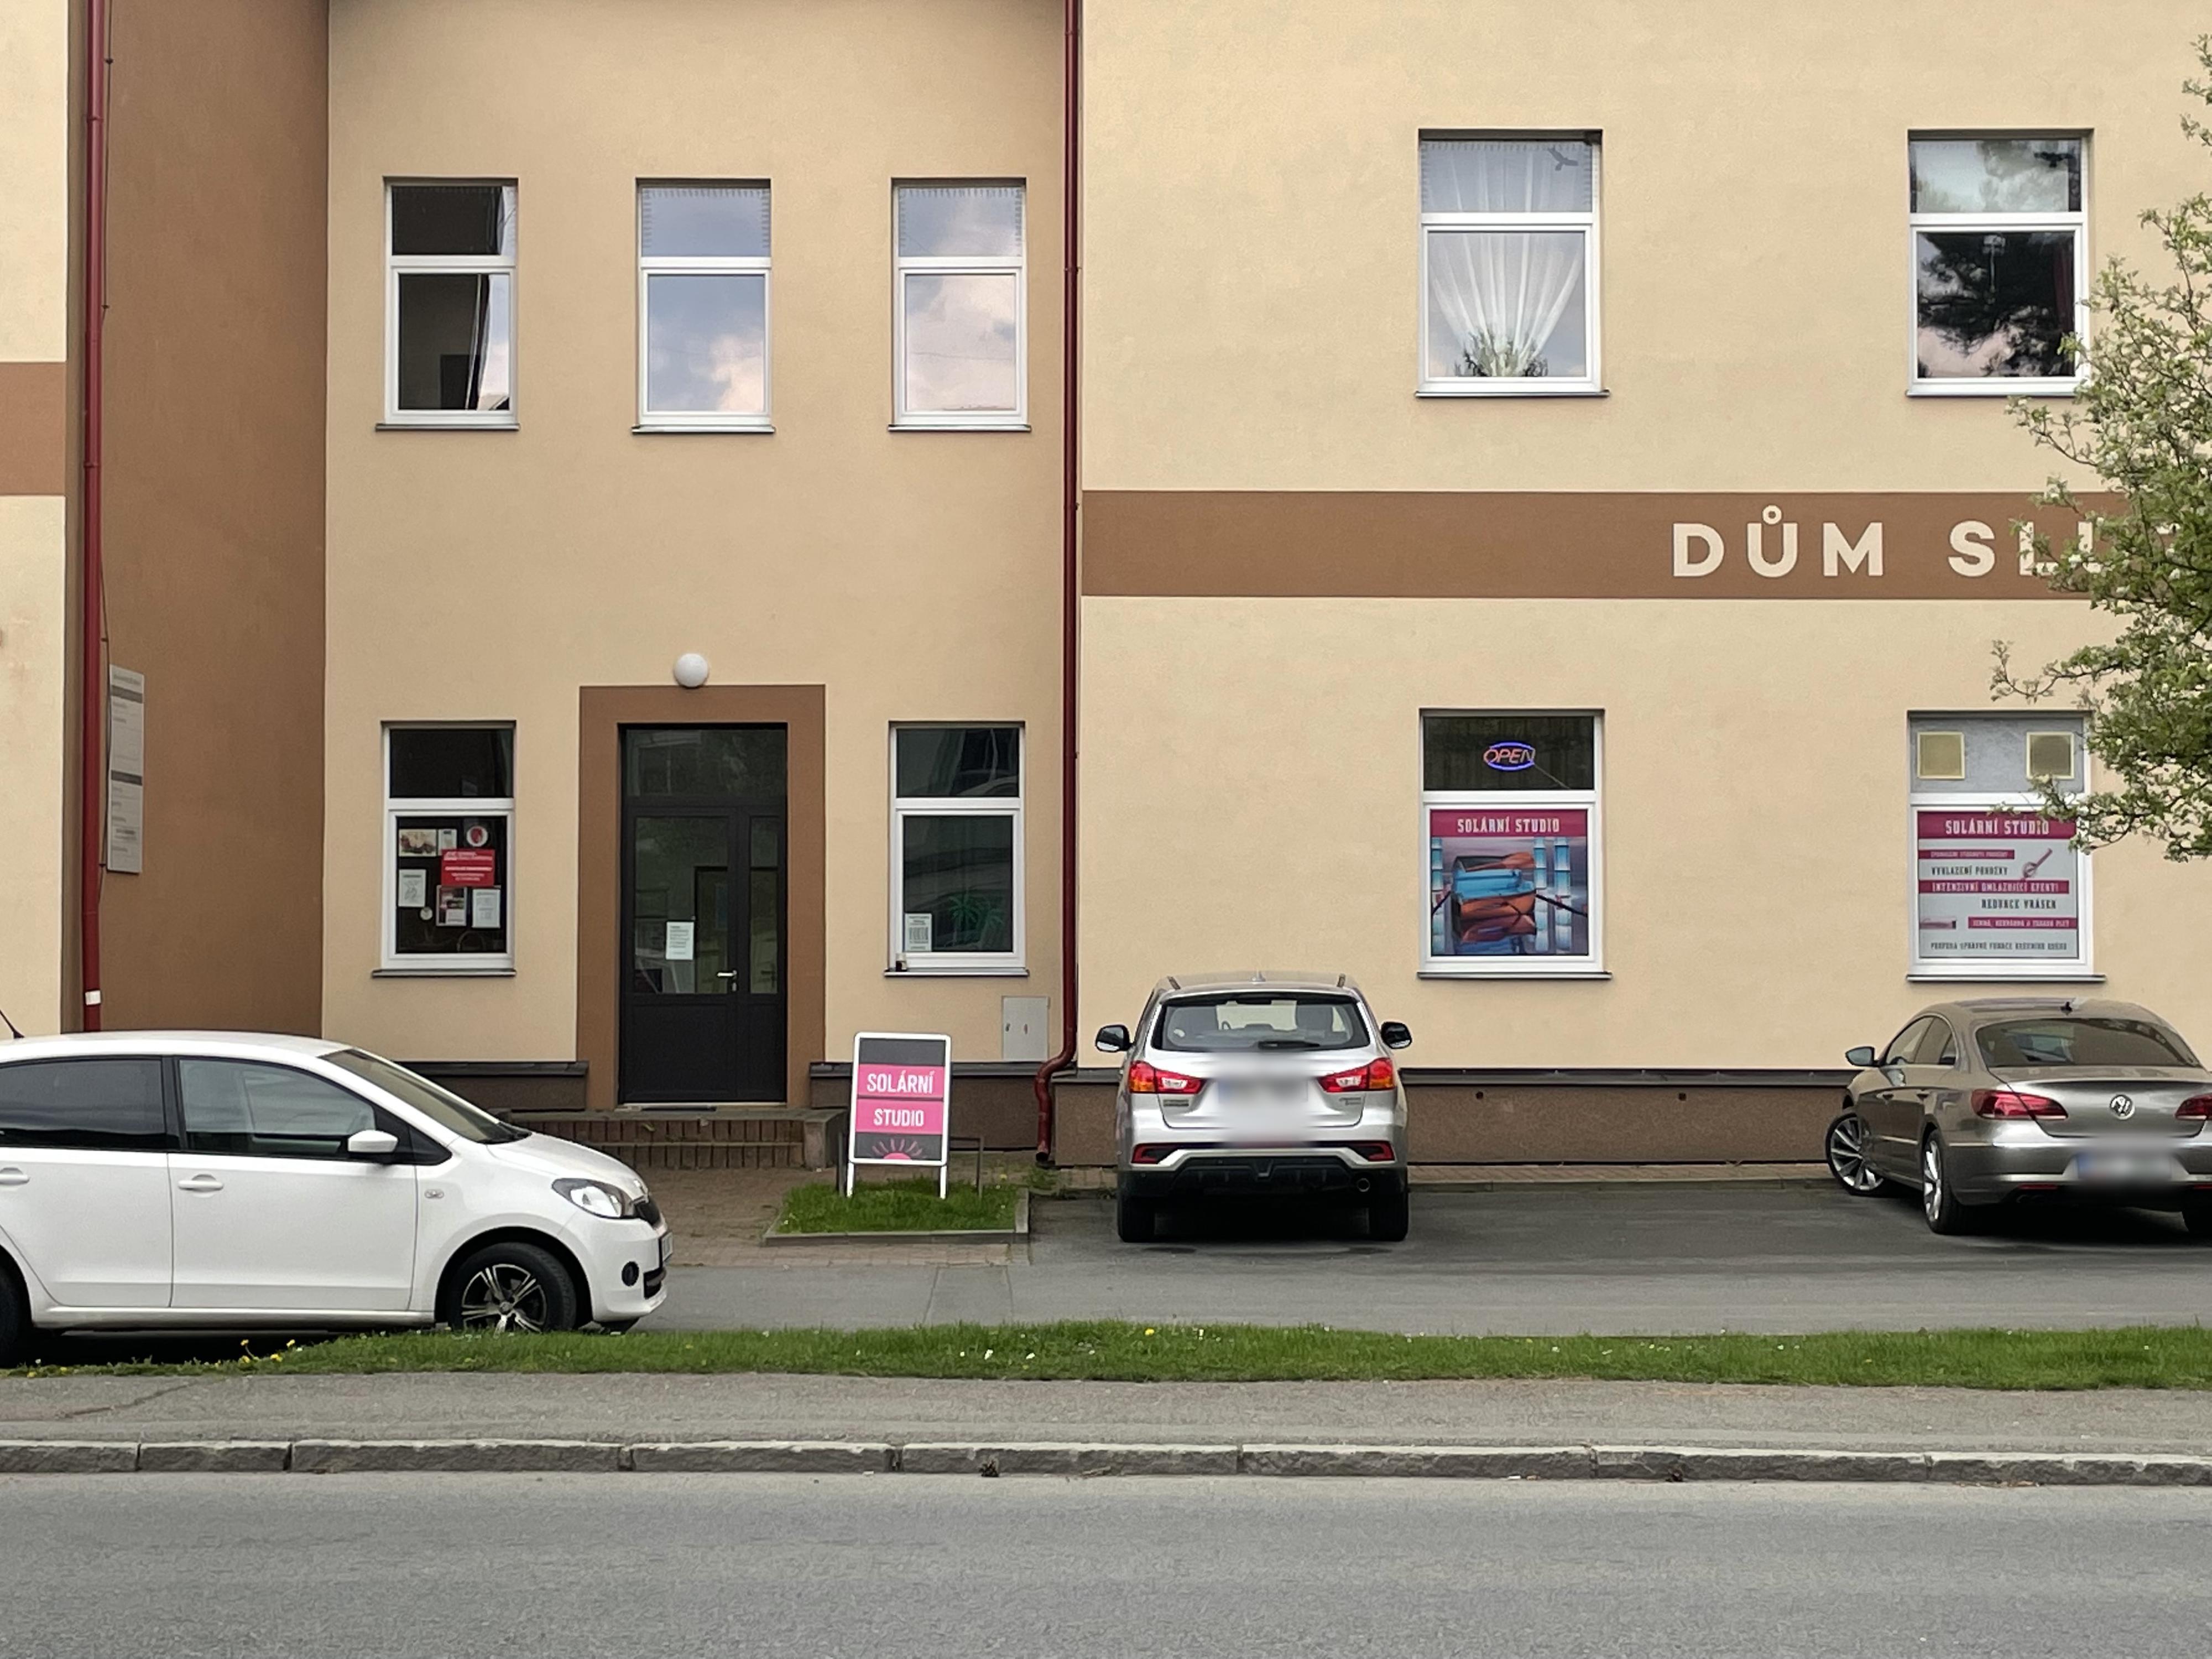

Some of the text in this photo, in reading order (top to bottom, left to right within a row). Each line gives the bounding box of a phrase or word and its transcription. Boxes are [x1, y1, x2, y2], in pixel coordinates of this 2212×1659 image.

[1672, 504, 1884, 577] DŮM
[1483, 748, 1536, 764] OPEN
[1457, 816, 1560, 833] SOLÁRNÍ STUDIO
[1945, 818, 2050, 835] SOLÁRNÍ STUDIO
[2024, 898, 2057, 909] VRÁSEK
[867, 1070, 935, 1094] SOLÁRNÍ
[873, 1108, 924, 1126] STUDIO
